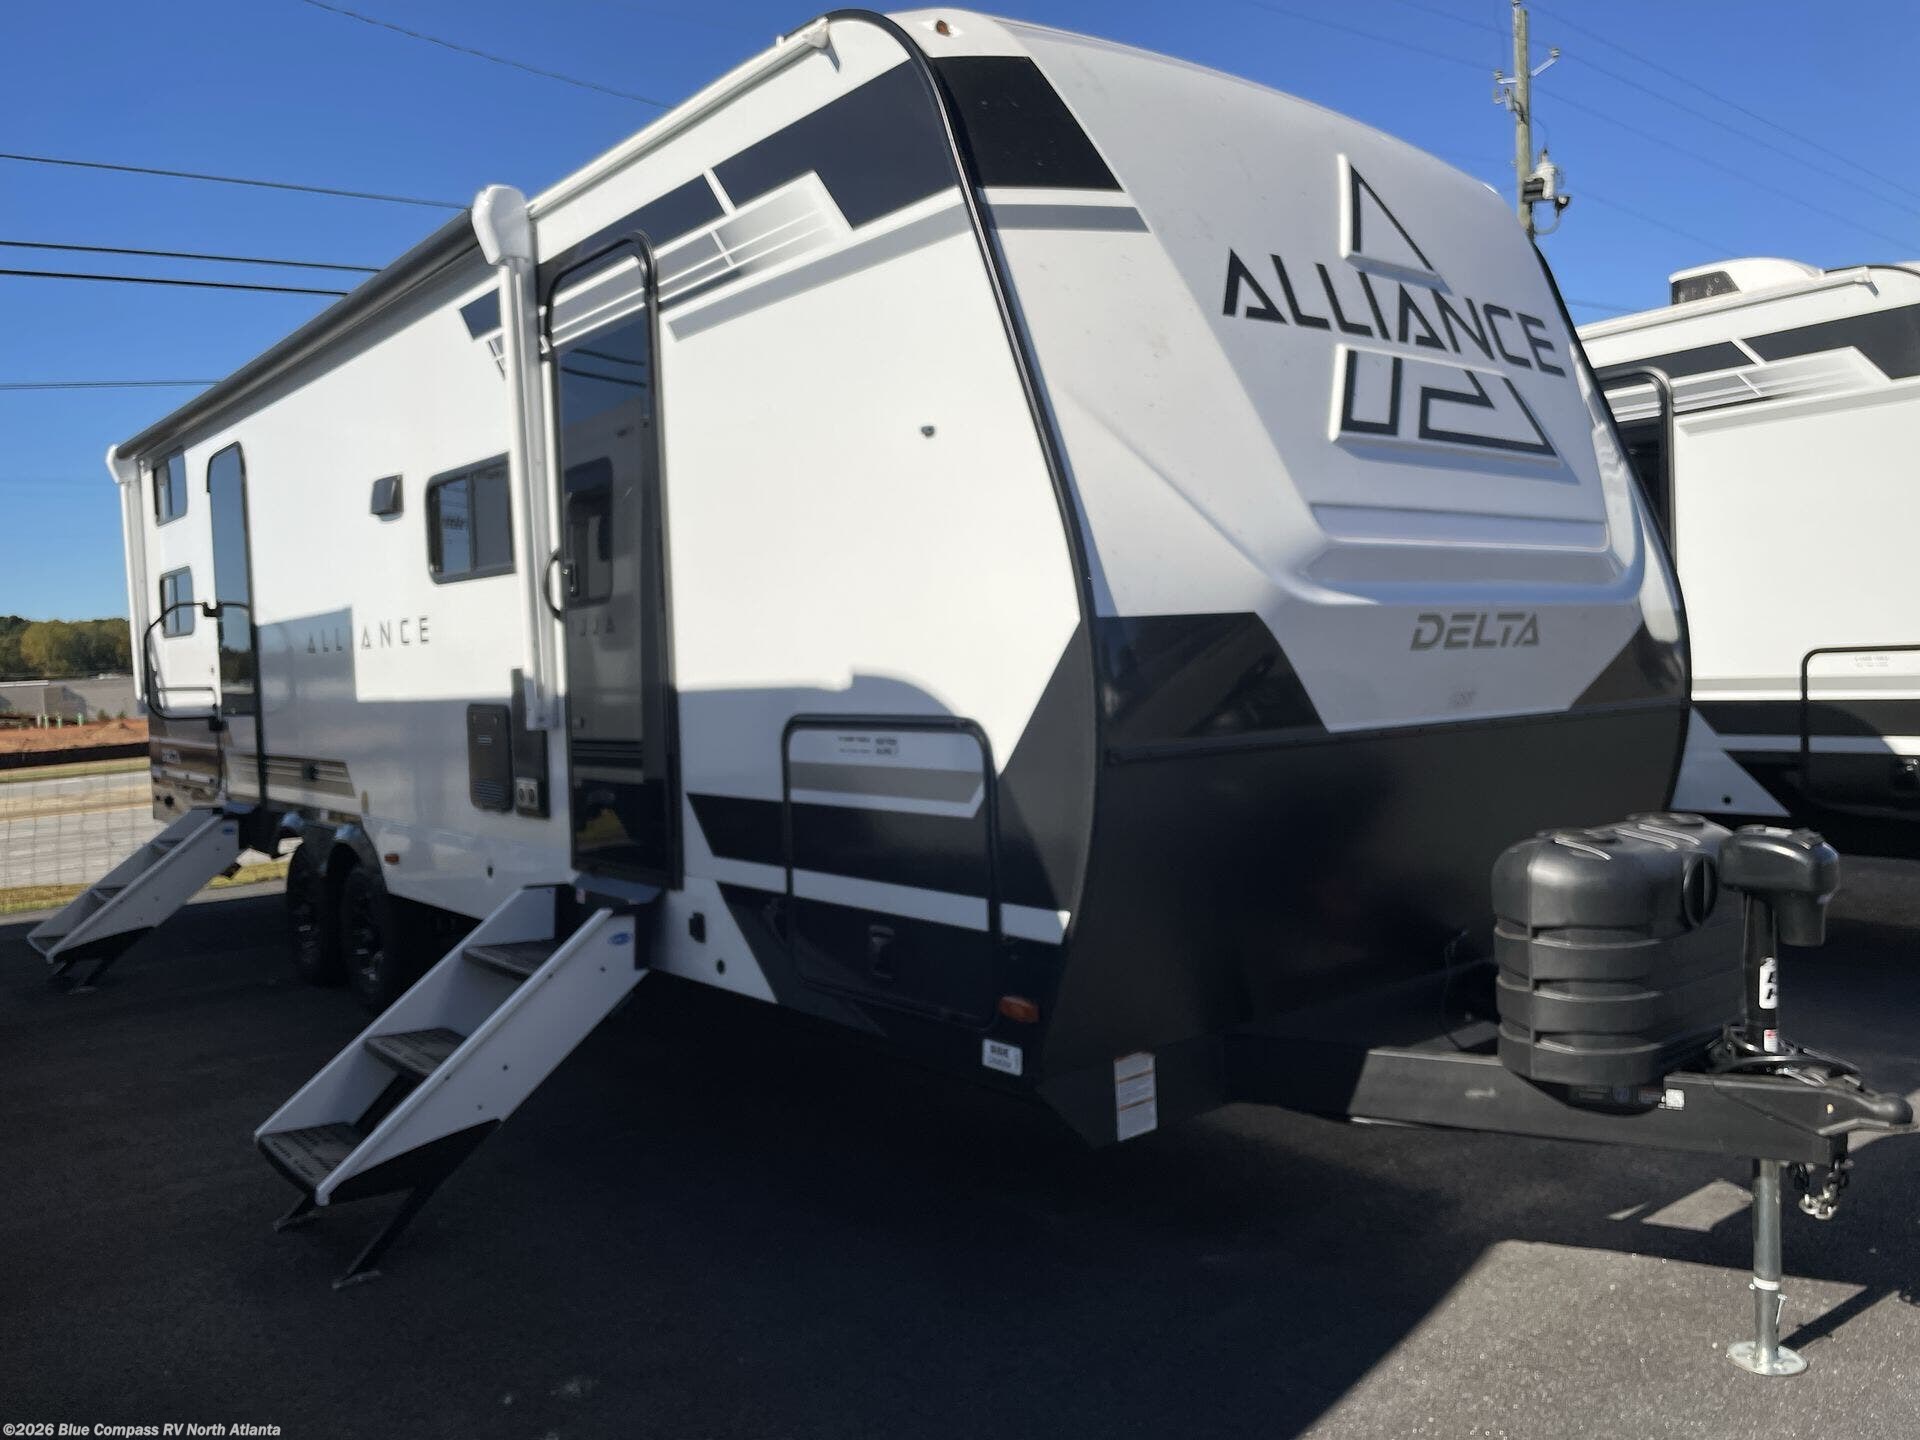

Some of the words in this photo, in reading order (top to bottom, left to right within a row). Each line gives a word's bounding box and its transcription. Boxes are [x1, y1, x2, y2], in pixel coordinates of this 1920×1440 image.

[1222, 248, 1566, 377] ALLIANCE
[307, 616, 429, 653] ALLANCE
[1410, 612, 1540, 651] DELTA
